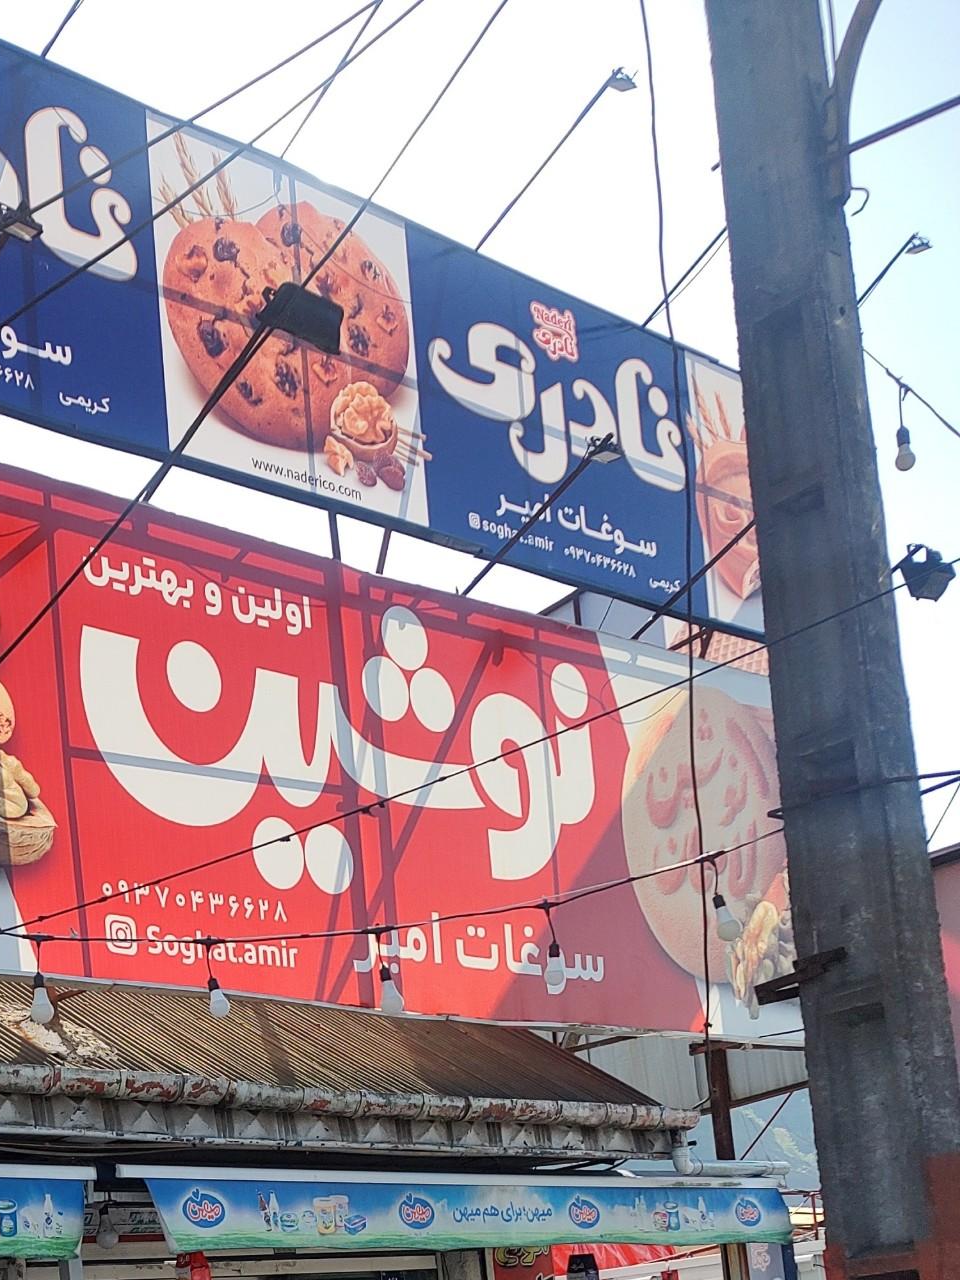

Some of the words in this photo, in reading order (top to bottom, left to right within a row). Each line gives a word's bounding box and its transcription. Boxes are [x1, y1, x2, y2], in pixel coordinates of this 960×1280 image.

[533, 305, 573, 332] Naderi
[58, 390, 111, 414] کریمی
[428, 322, 687, 492] نادری
[251, 457, 362, 501] www.naderico.com
[496, 493, 552, 523] امیر
[557, 505, 658, 558] سوغات
[82, 547, 194, 609] بهترین
[649, 577, 681, 593] کریمی
[204, 582, 222, 616] و
[232, 586, 312, 636] اولین
[79, 605, 597, 894] نوشین
[102, 880, 288, 923] ۰۹۳۷۰۴۳۶۶۲۸
[146, 924, 298, 969] Soghat.amir
[352, 912, 443, 972] امیر
[187, 1200, 222, 1222] میهن
[401, 1201, 435, 1222] میهن
[452, 1206, 481, 1223] میهن
[482, 1207, 500, 1223] هم
[501, 1200, 522, 1223] برای
[571, 1206, 598, 1224] میهن
